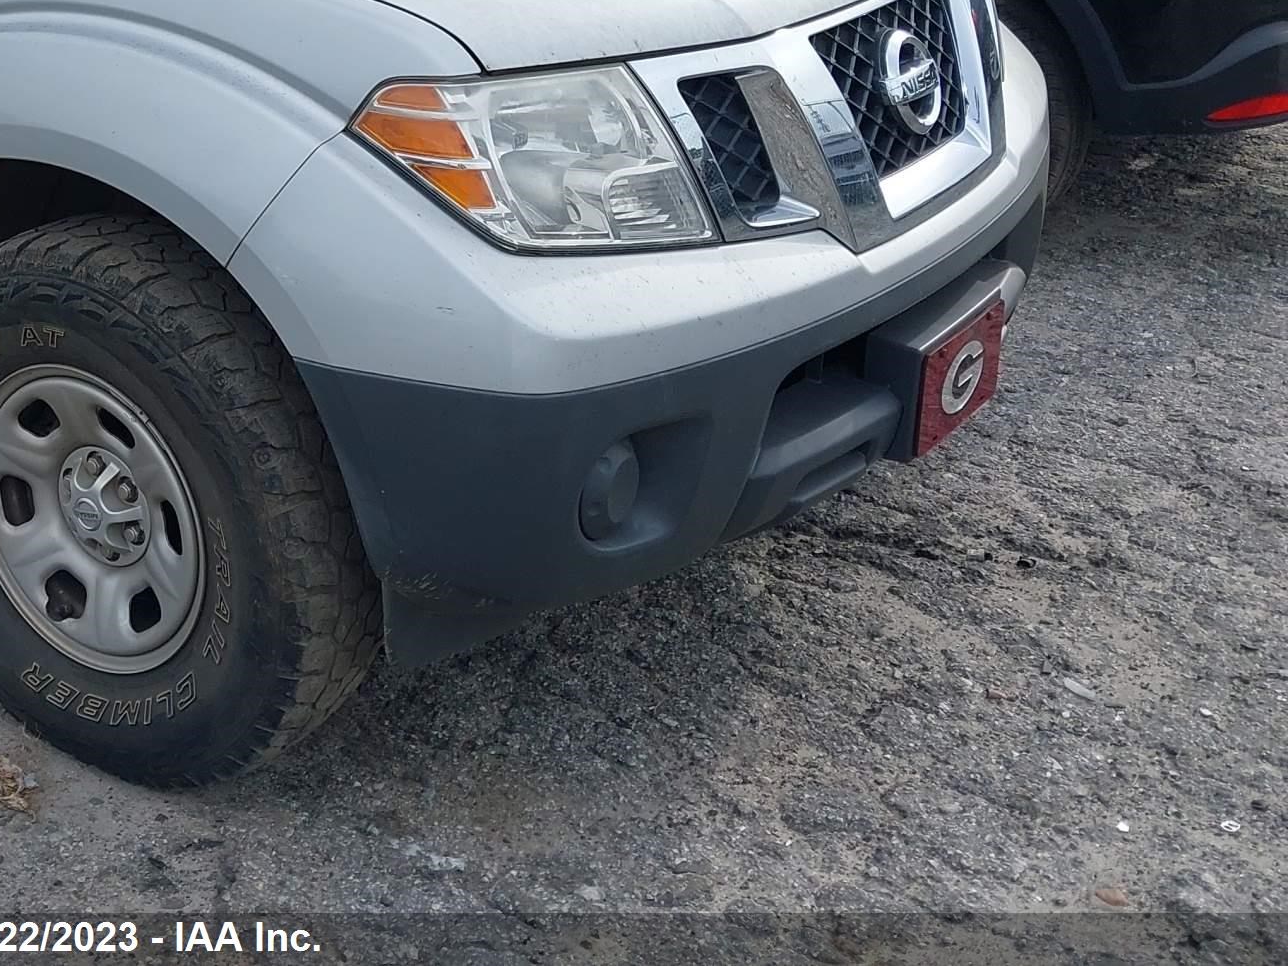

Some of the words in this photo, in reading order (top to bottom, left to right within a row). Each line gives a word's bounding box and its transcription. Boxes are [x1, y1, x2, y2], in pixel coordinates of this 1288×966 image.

[21, 325, 65, 348] AT
[941, 340, 985, 415] G
[202, 516, 233, 666] TRAIL
[20, 661, 198, 726] CLIMBER
